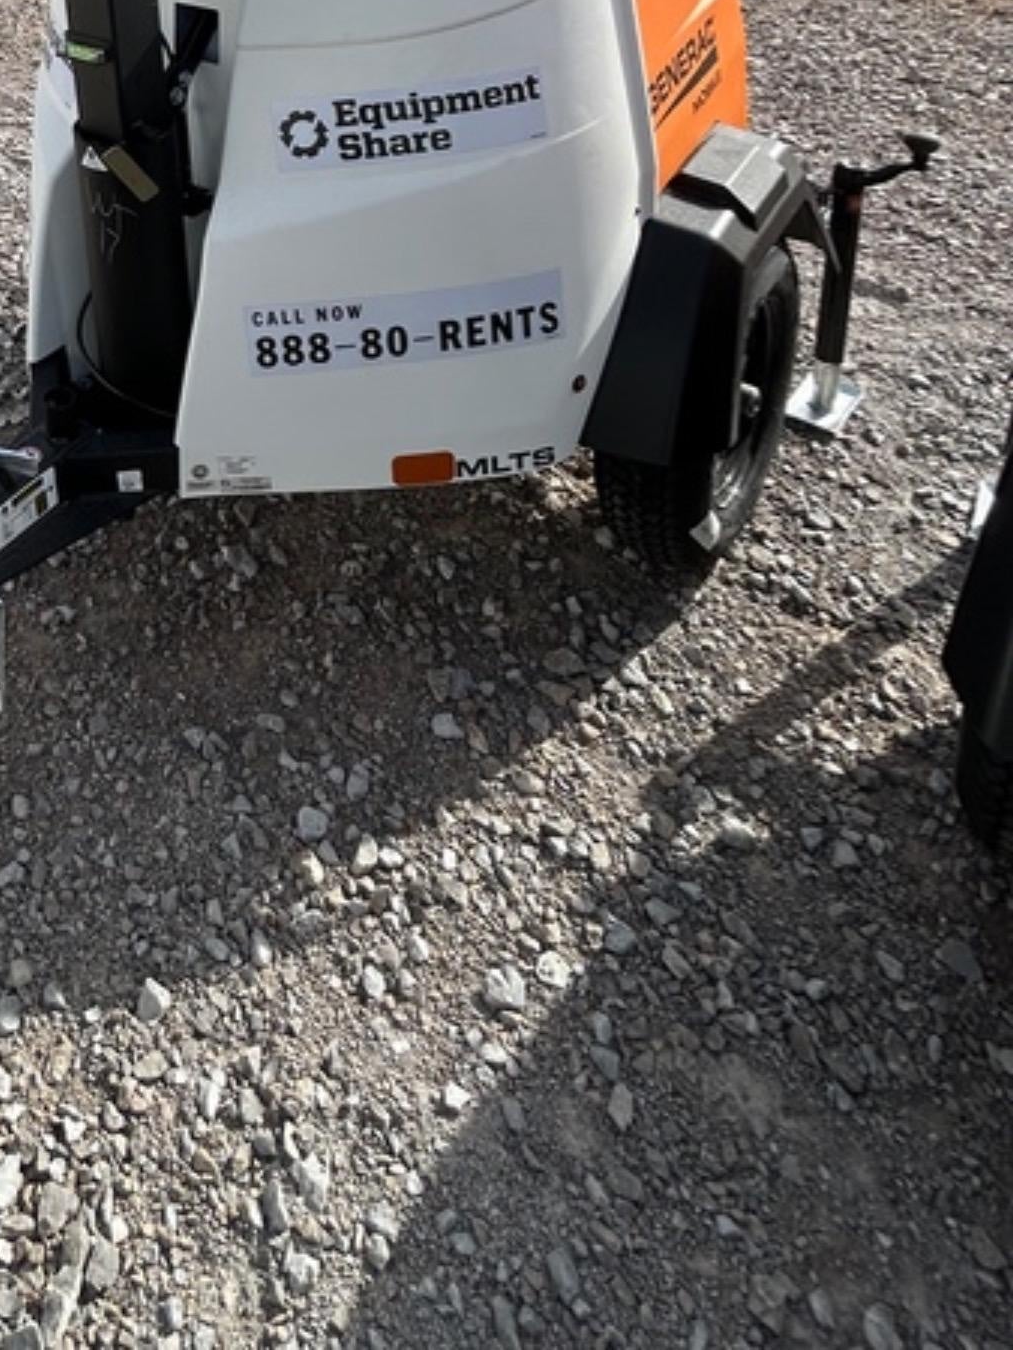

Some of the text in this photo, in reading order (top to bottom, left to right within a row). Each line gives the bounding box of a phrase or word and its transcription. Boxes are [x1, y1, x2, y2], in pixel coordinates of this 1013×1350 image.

[332, 74, 540, 130] Equipment
[337, 129, 453, 160] Share
[252, 304, 362, 327] CALL NOW
[256, 301, 559, 368] 888-80-RENTS
